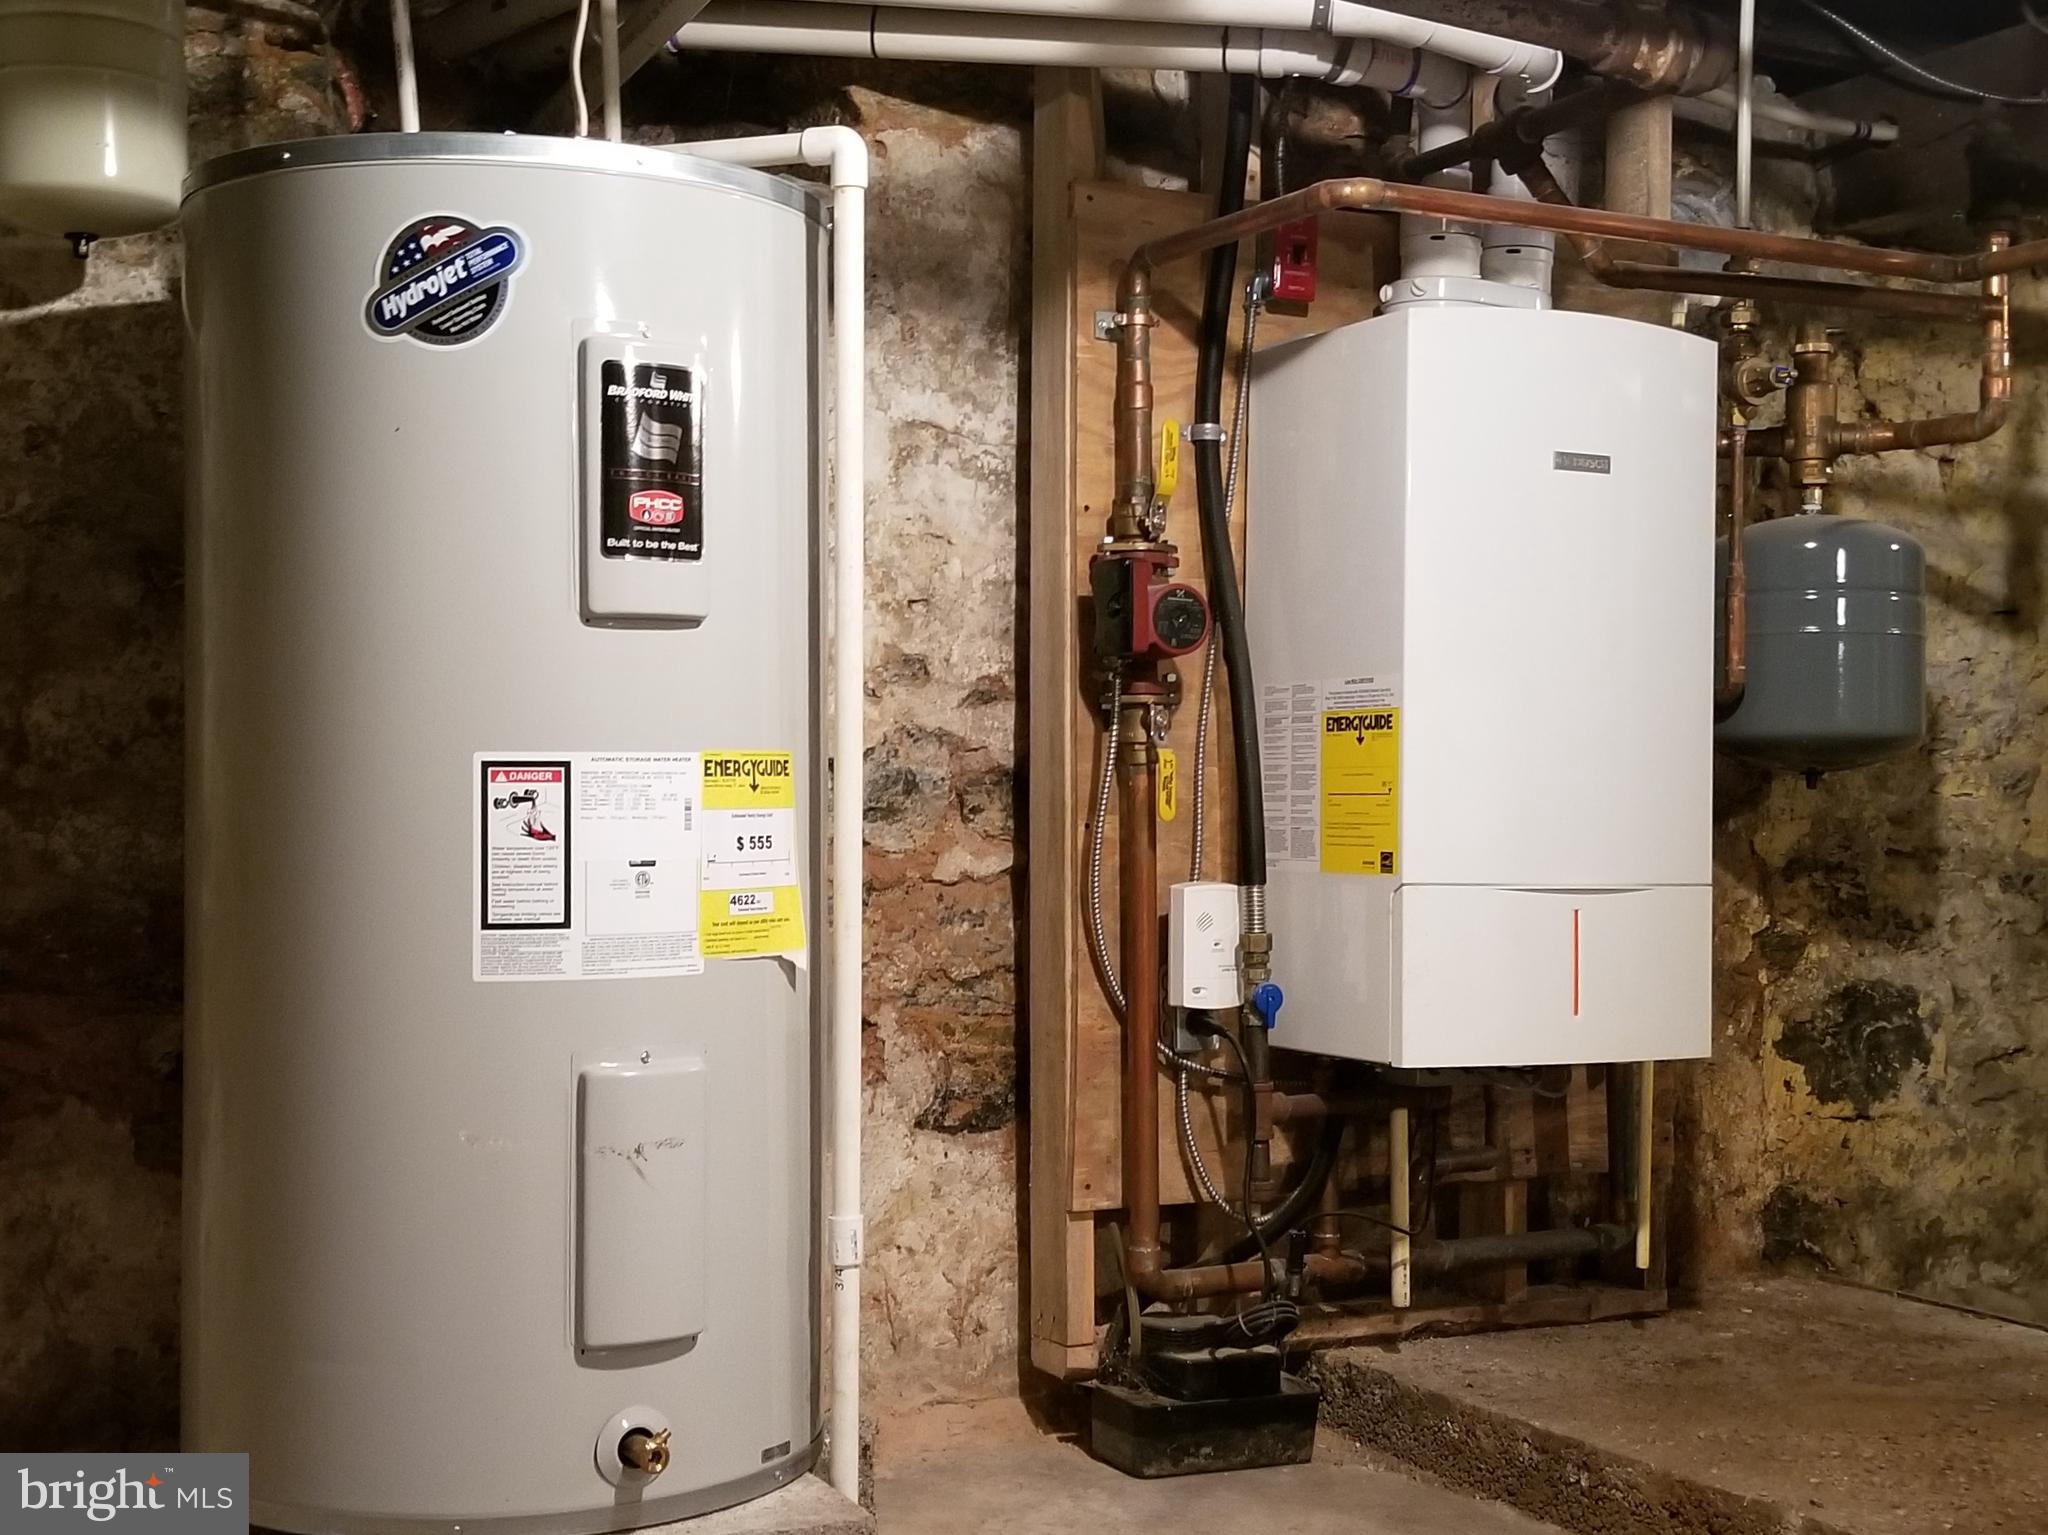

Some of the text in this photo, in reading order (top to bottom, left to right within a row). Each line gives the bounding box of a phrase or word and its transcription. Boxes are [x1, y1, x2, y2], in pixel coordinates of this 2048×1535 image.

[381, 255, 468, 321] Hydrojet
[633, 496, 683, 511] PHCC
[607, 537, 699, 552] Built to be the Best
[1325, 714, 1394, 733] ENERGYGUIDE
[508, 771, 553, 781] DANGER
[703, 759, 790, 777] ENERGYGUIDE
[737, 835, 773, 852] $ 555
[729, 894, 756, 906] 4622
